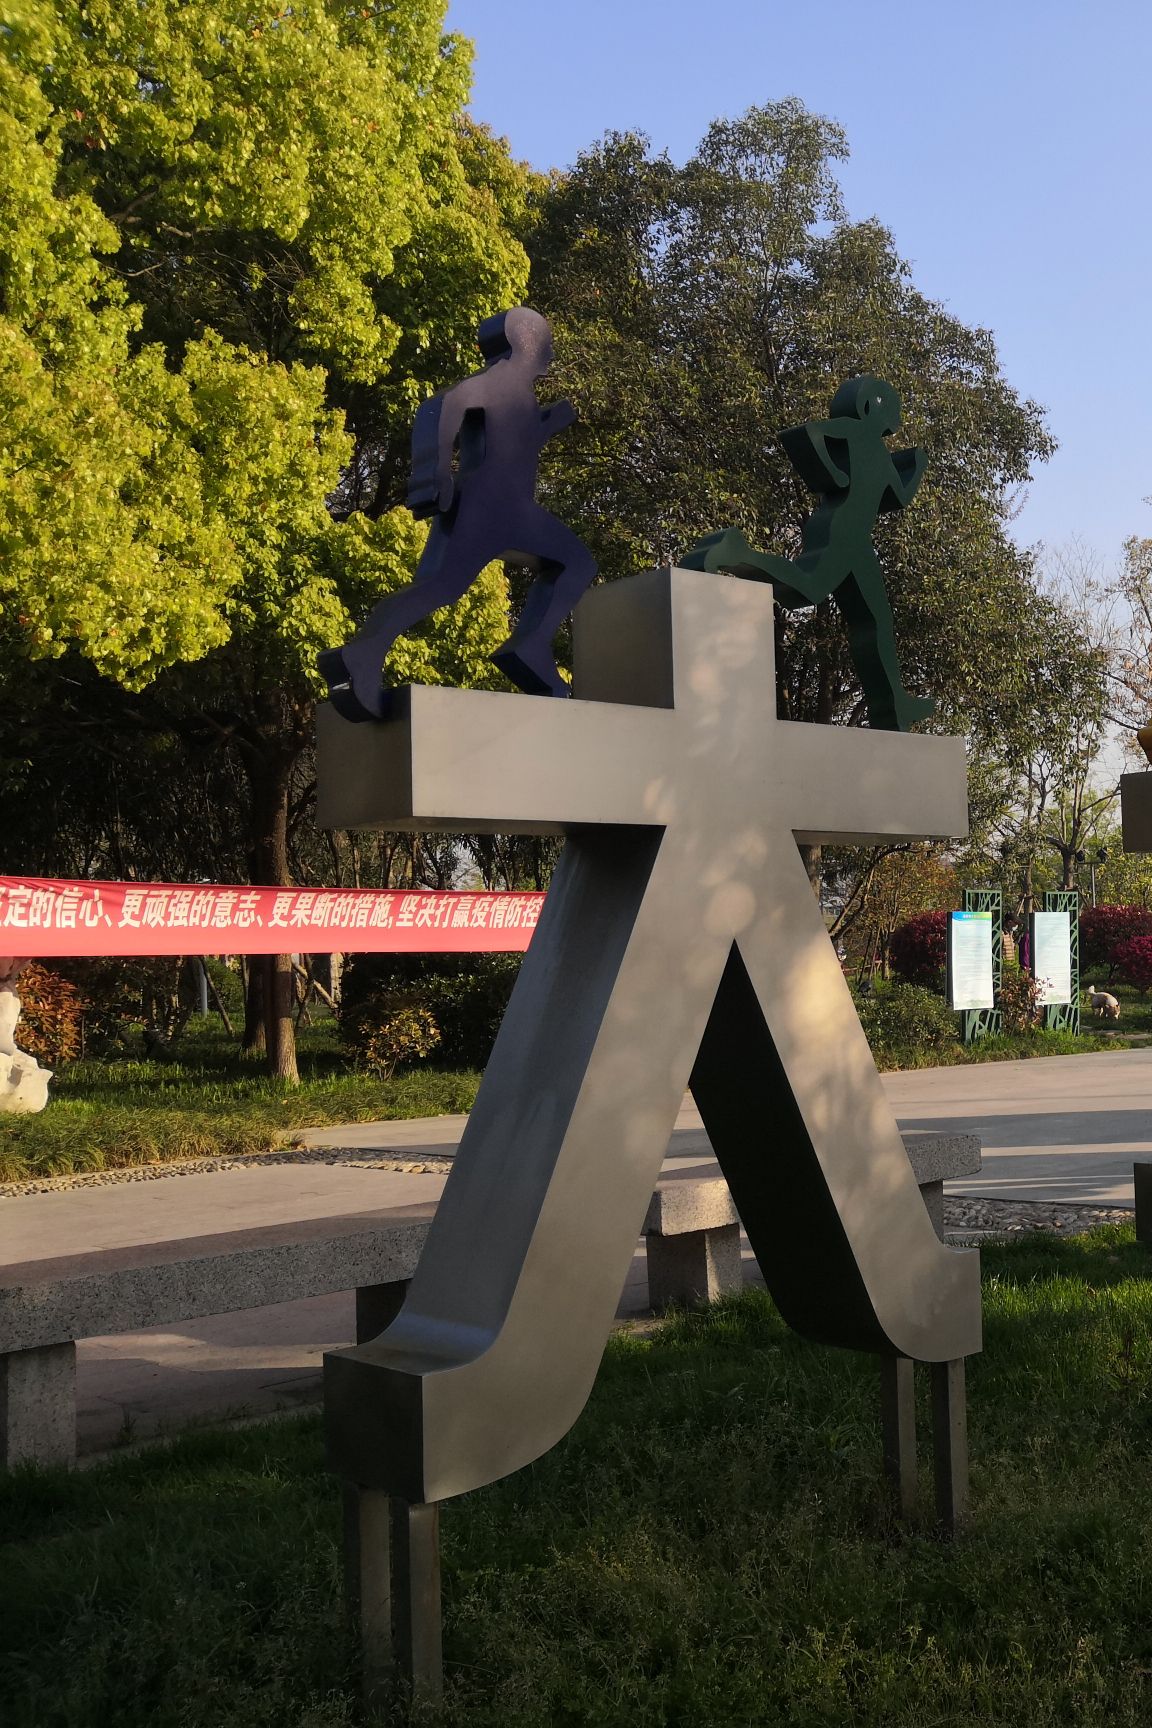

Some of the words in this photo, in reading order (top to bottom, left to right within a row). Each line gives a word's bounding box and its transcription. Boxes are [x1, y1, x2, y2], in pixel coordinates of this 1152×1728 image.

[0, 886, 545, 929] 定的信心、更顽强的意志、更果断的措施，坚决打赢疫情防控
